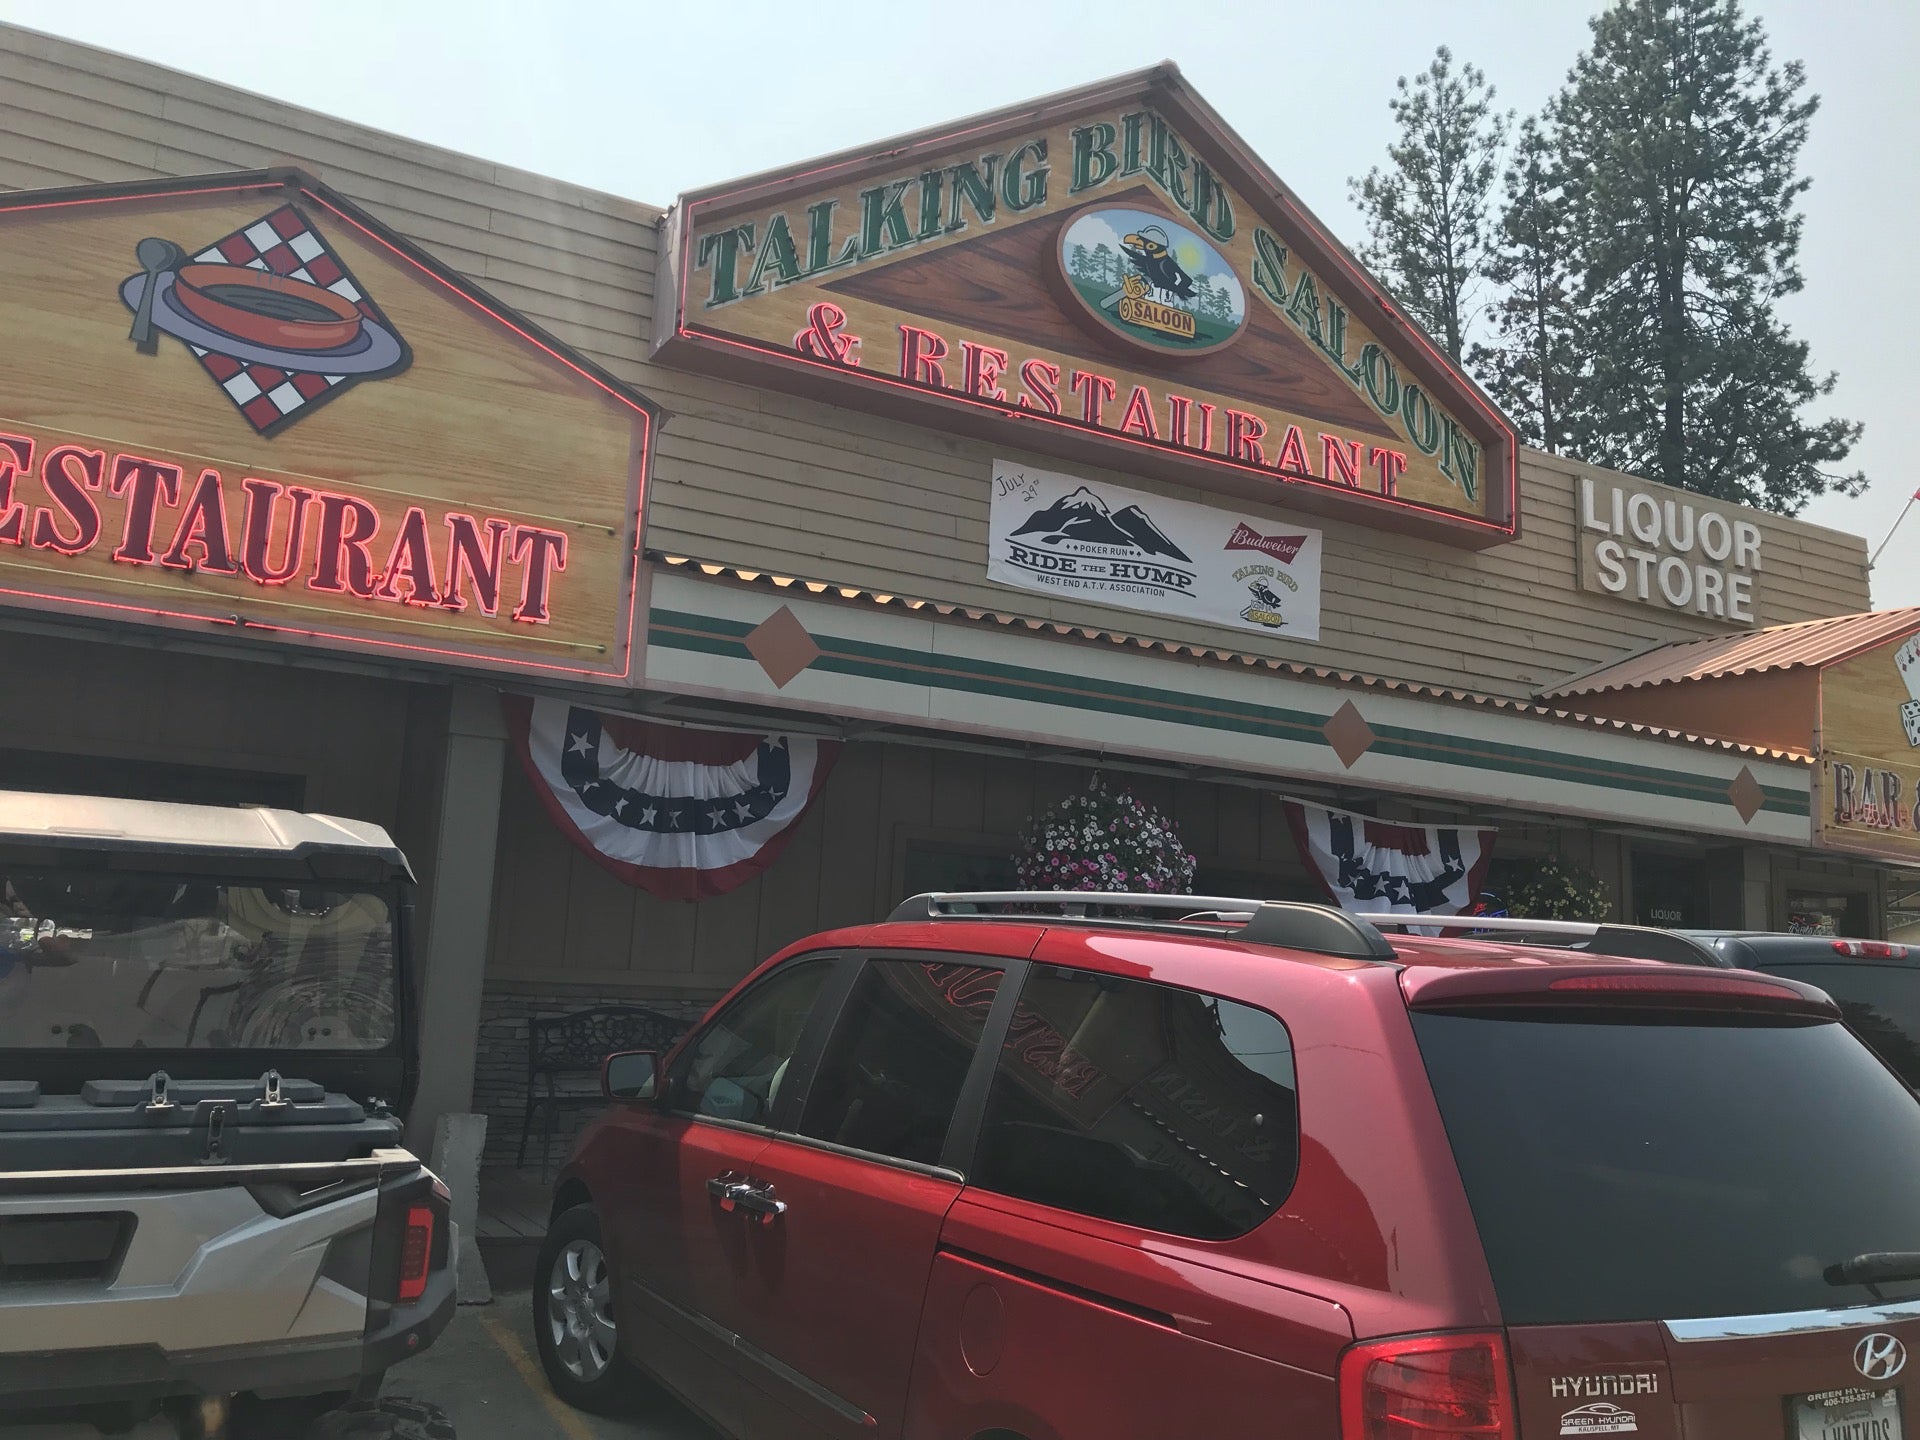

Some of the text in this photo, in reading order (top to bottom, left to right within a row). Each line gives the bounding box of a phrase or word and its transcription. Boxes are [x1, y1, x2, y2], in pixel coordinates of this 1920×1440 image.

[696, 109, 1480, 505] TALKING BIRD SALOON
[1133, 302, 1192, 333] SALOON
[794, 302, 1408, 498] & RESTAURANT
[996, 473, 1025, 497] JULY
[1582, 478, 1762, 570] LIQUOR
[1080, 544, 1128, 556] POKER RUN
[1230, 527, 1300, 555] Budweiser
[1009, 545, 1192, 589] RIDE THE HUMP
[1231, 564, 1299, 592] TALKING BIRD
[1594, 539, 1754, 623] STORE
[1037, 574, 1165, 598] WEST END A.T.V. ASSOCIATION
[1253, 611, 1280, 623] SALOON
[1831, 761, 1902, 832] BAR
[1650, 908, 1682, 921] LIQUOR
[1551, 1373, 1658, 1398] HYUNDAI
[1807, 1390, 1843, 1402] GREEN
[1561, 1416, 1636, 1426] GREEN HYUNDAI
